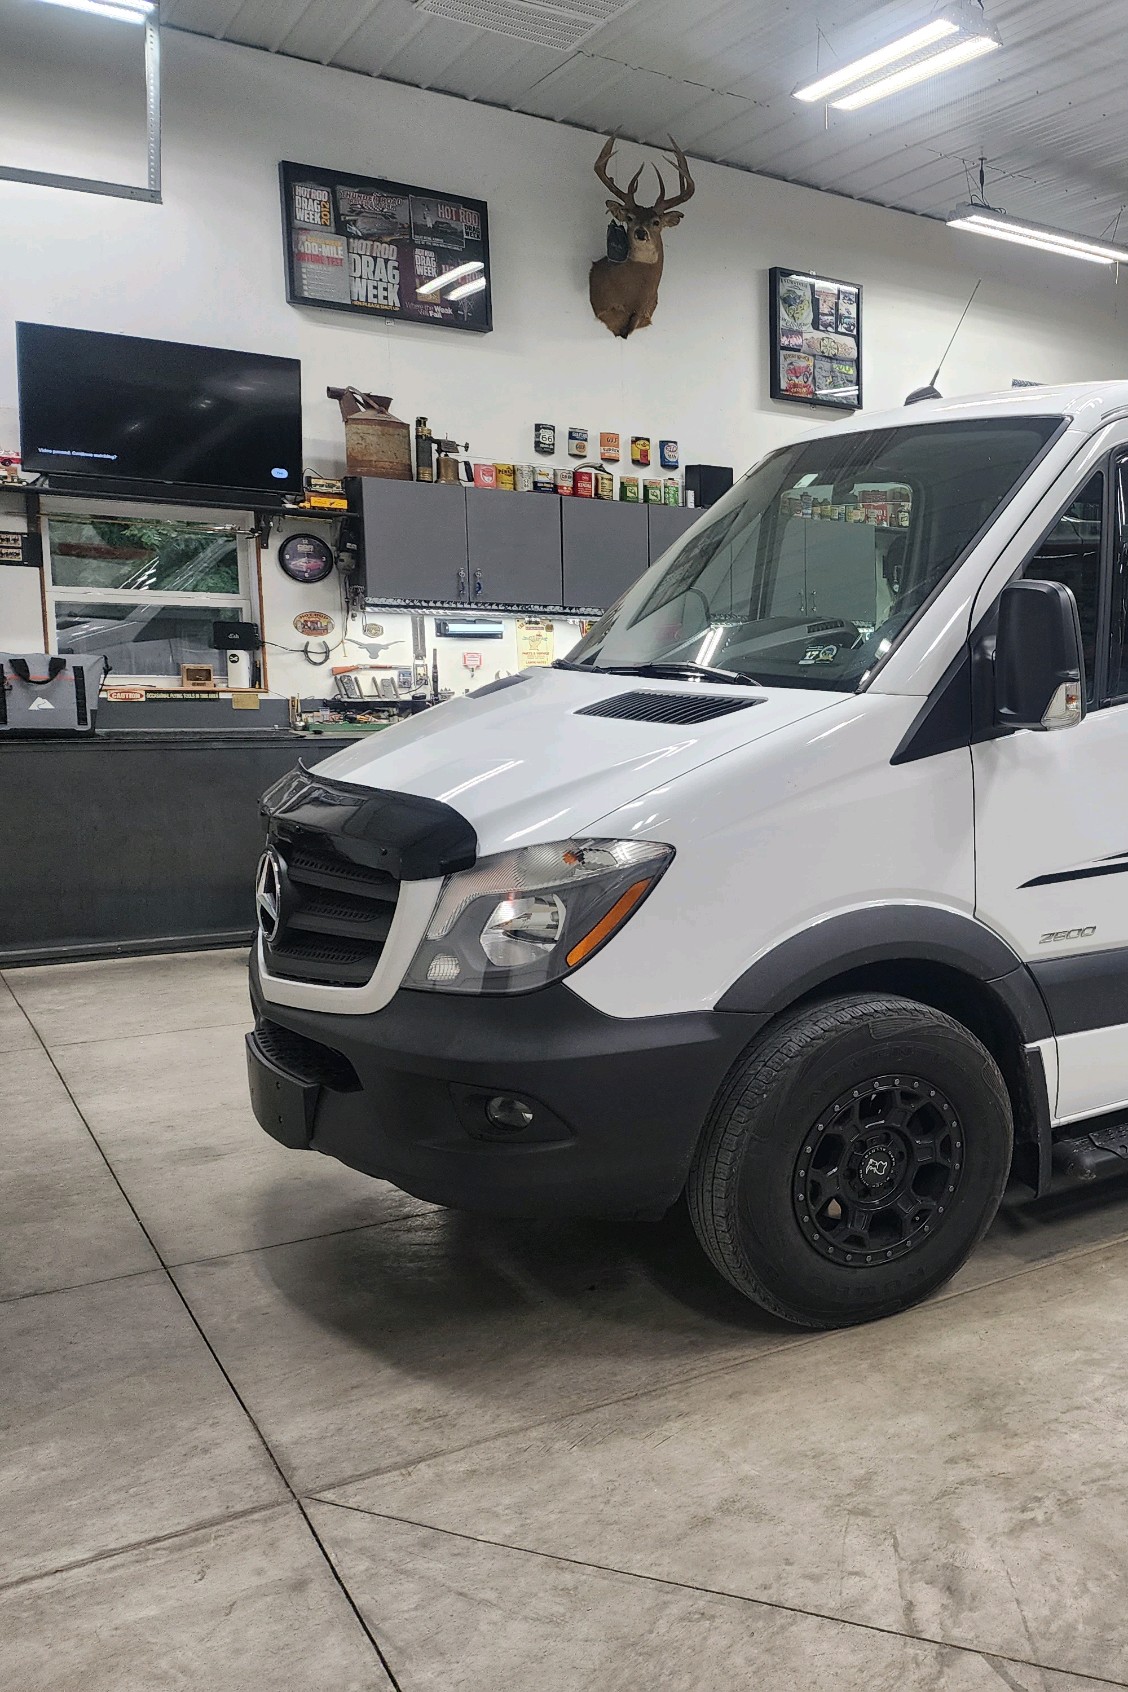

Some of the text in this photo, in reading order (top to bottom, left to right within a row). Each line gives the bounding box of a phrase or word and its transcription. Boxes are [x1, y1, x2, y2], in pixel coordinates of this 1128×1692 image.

[295, 196, 321, 211] DRAG
[295, 208, 321, 224] WEEK
[321, 200, 330, 225] 2012
[437, 203, 479, 226] HOT ROD
[348, 253, 400, 285] DRAG
[414, 254, 436, 267] DRAG
[415, 264, 437, 277] WEEK
[350, 277, 401, 307] WEEK
[111, 691, 141, 700] CAUTION
[1039, 926, 1096, 944] 2500
